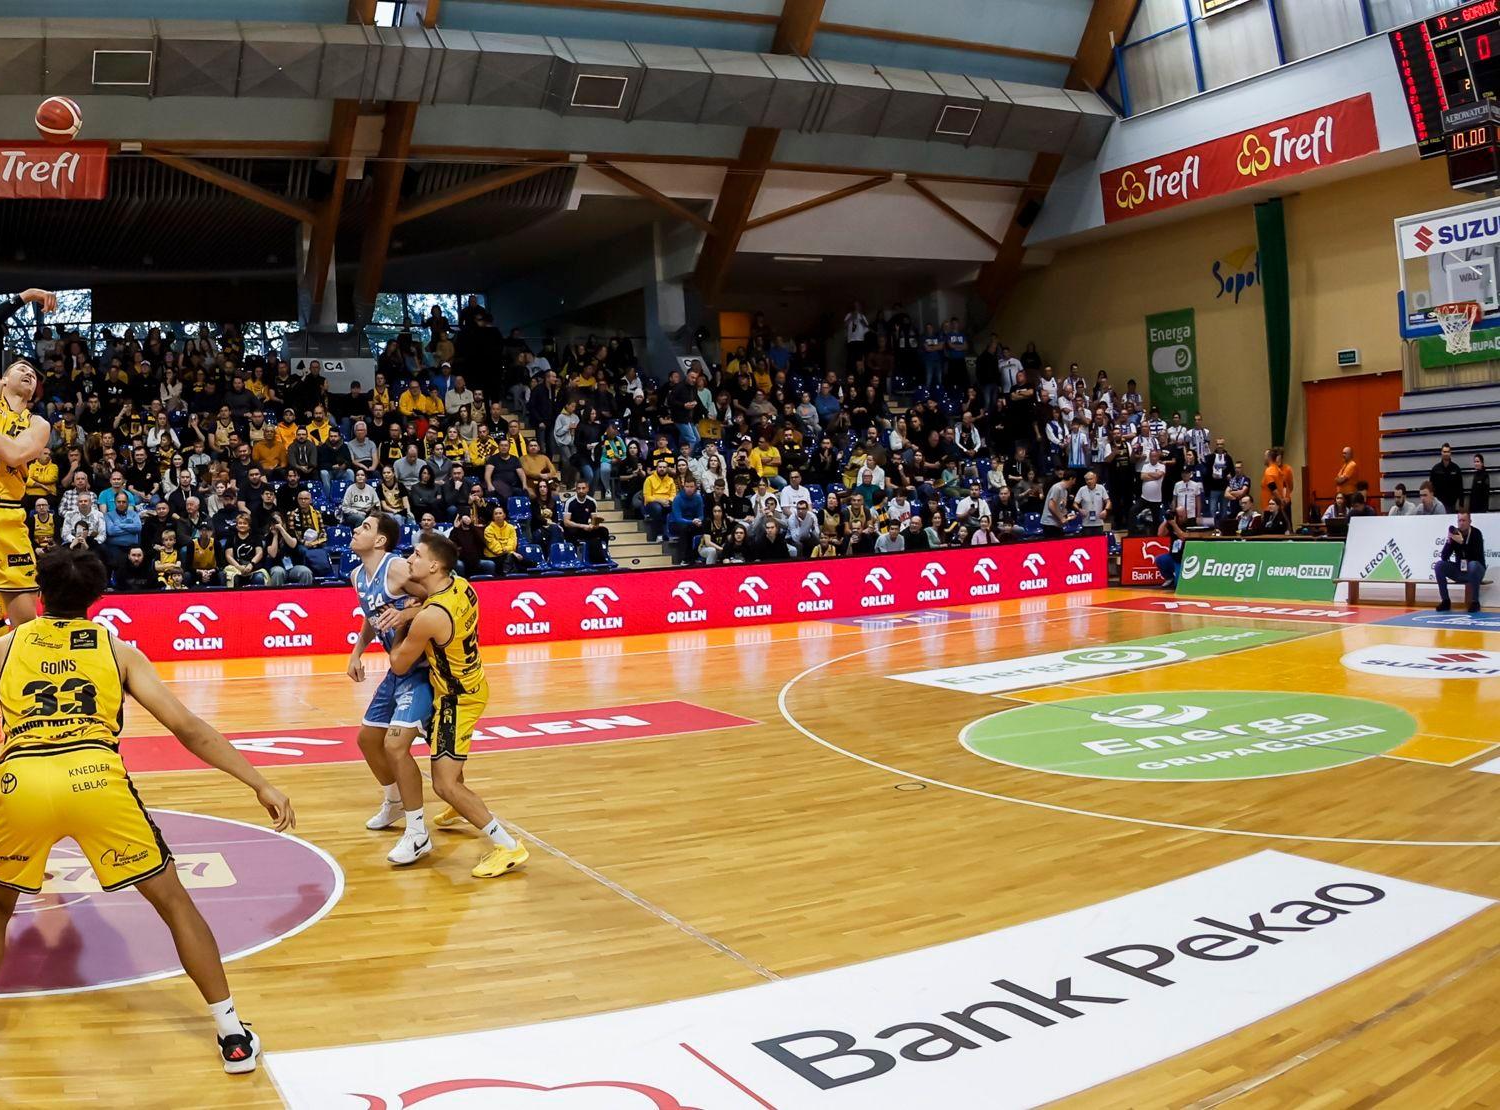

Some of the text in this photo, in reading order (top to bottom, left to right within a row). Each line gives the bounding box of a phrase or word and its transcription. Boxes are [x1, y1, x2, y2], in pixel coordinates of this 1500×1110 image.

[1445, 105, 1489, 124] AEROWATCH
[1268, 115, 1333, 167] Trefl
[1452, 127, 1486, 149] 10.00
[0, 150, 81, 189] Trefl
[1144, 155, 1200, 201] Trefl
[1150, 325, 1191, 343] Energa
[324, 361, 344, 372] C4
[1164, 375, 1193, 387] włącza
[1172, 386, 1194, 398] sport
[353, 494, 370, 503] GAP
[1360, 545, 1389, 579] LEROY
[1386, 538, 1413, 580] MERLIN
[1131, 570, 1148, 582] Bank
[1202, 558, 1332, 583] Energa GRUPA ORLEN
[1019, 578, 1048, 592] ORLEN
[1065, 572, 1093, 586] ORLEN
[917, 588, 949, 602] ORLEN
[969, 583, 1000, 597] ORLEN
[367, 592, 384, 611] 24
[797, 599, 833, 613] ORLEN
[860, 594, 895, 608] ORLEN
[667, 609, 707, 624] ORLEN
[734, 604, 772, 618] ORLEN
[1209, 604, 1358, 619] ORLEN
[505, 621, 550, 636] ORLEN
[580, 616, 623, 631] ORLEN
[173, 637, 223, 651] ORLEN
[263, 634, 313, 648] ORLEN
[40, 659, 77, 675] GOINS
[937, 661, 1077, 686] Energa
[20, 678, 98, 717] 33
[1081, 712, 1329, 756] Energa
[1137, 727, 1377, 771] GRUPA ORLEN
[68, 763, 111, 778] KNEDLER
[751, 881, 1387, 1091] Bank Pekao
